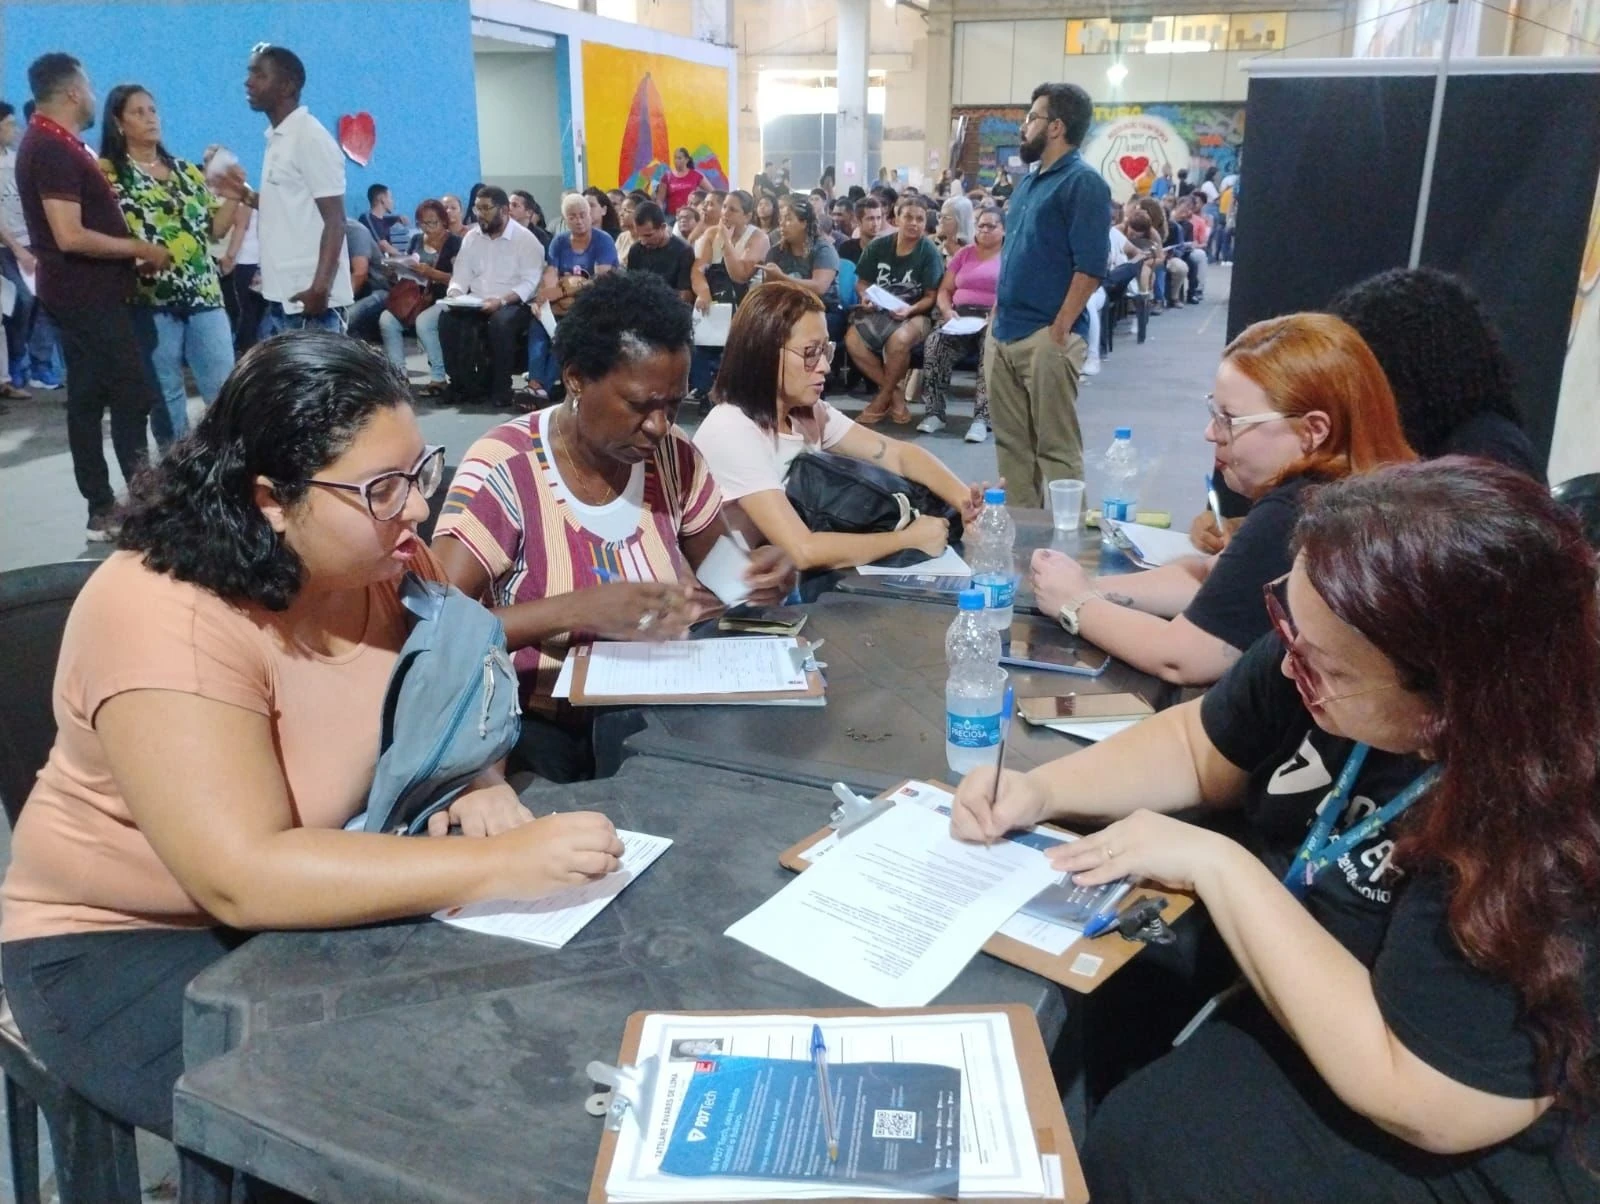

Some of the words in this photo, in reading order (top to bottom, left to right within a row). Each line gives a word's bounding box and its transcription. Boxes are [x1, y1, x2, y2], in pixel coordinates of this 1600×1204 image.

[951, 727, 987, 738] PRECIOSA
[669, 1072, 678, 1088] LIMA
[667, 1089, 675, 1097] DE
[661, 1099, 674, 1126] TAVARES
